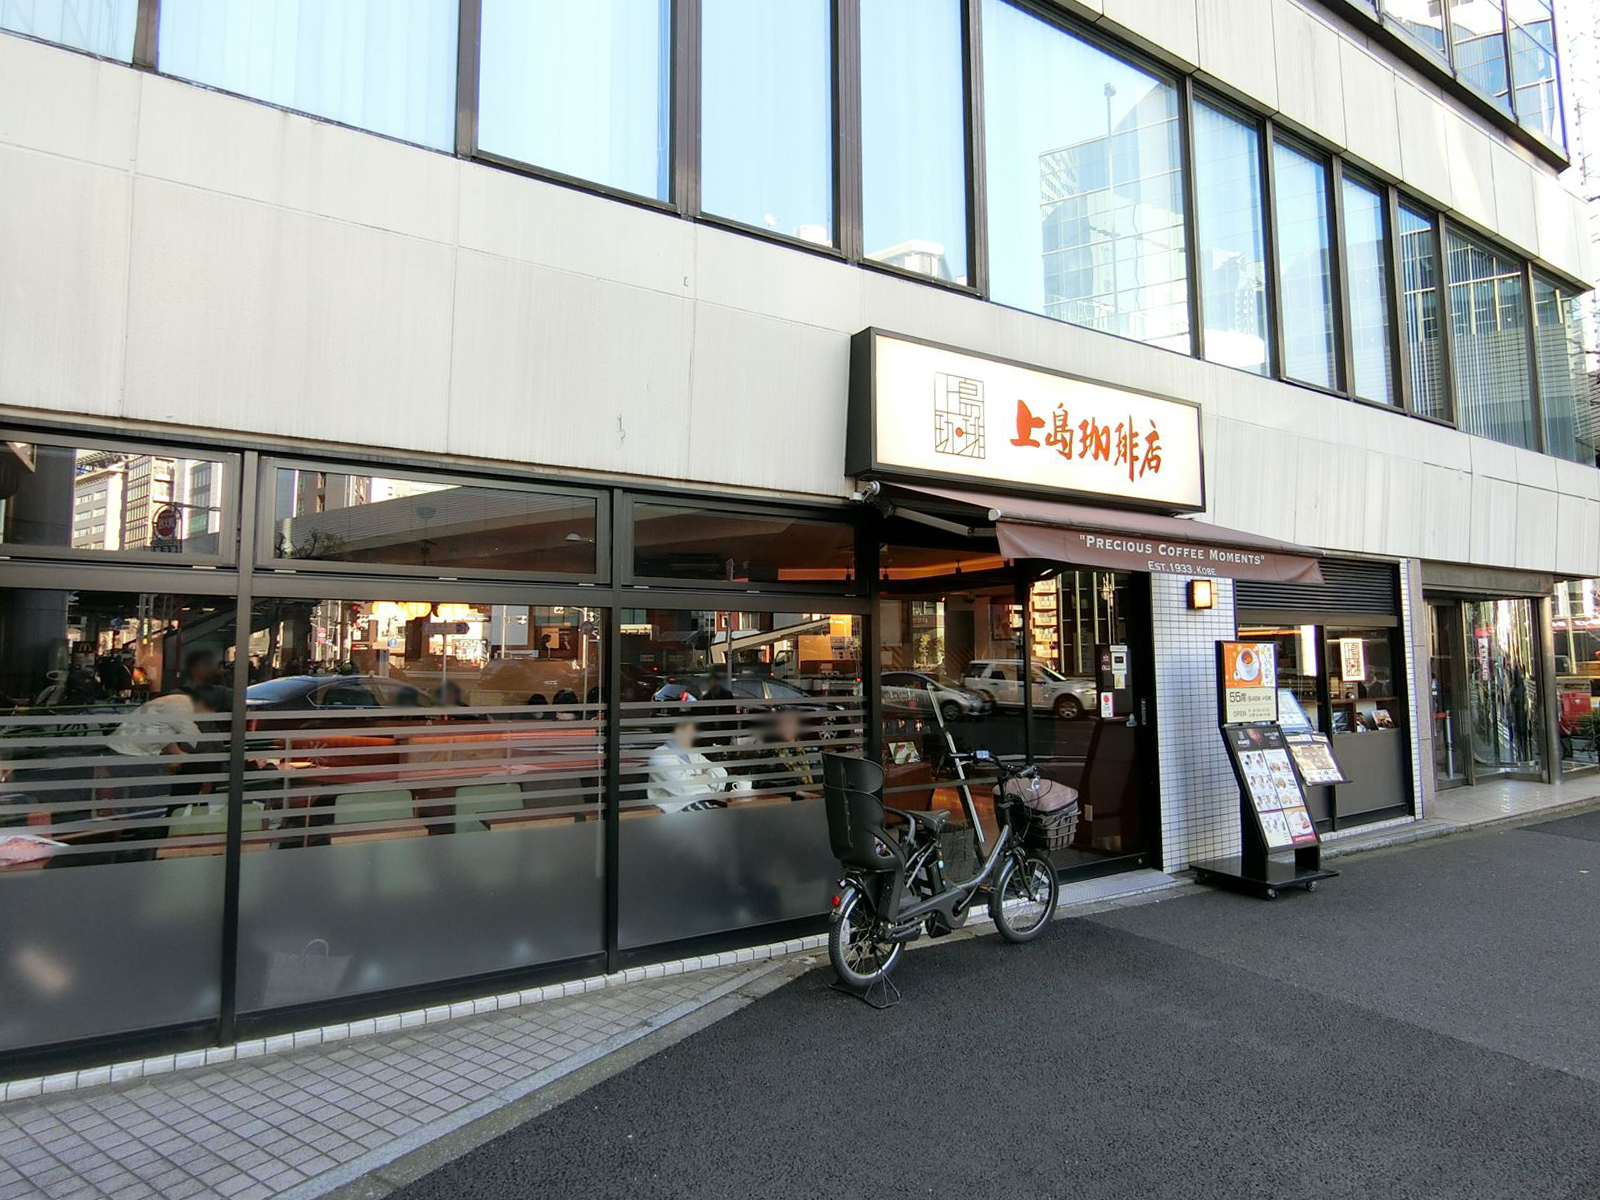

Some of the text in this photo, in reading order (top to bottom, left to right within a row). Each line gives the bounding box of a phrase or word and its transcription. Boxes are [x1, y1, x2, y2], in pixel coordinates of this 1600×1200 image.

[1010, 399, 1162, 482] 上島珈琲店
[1158, 543, 1204, 559] COFFEE
